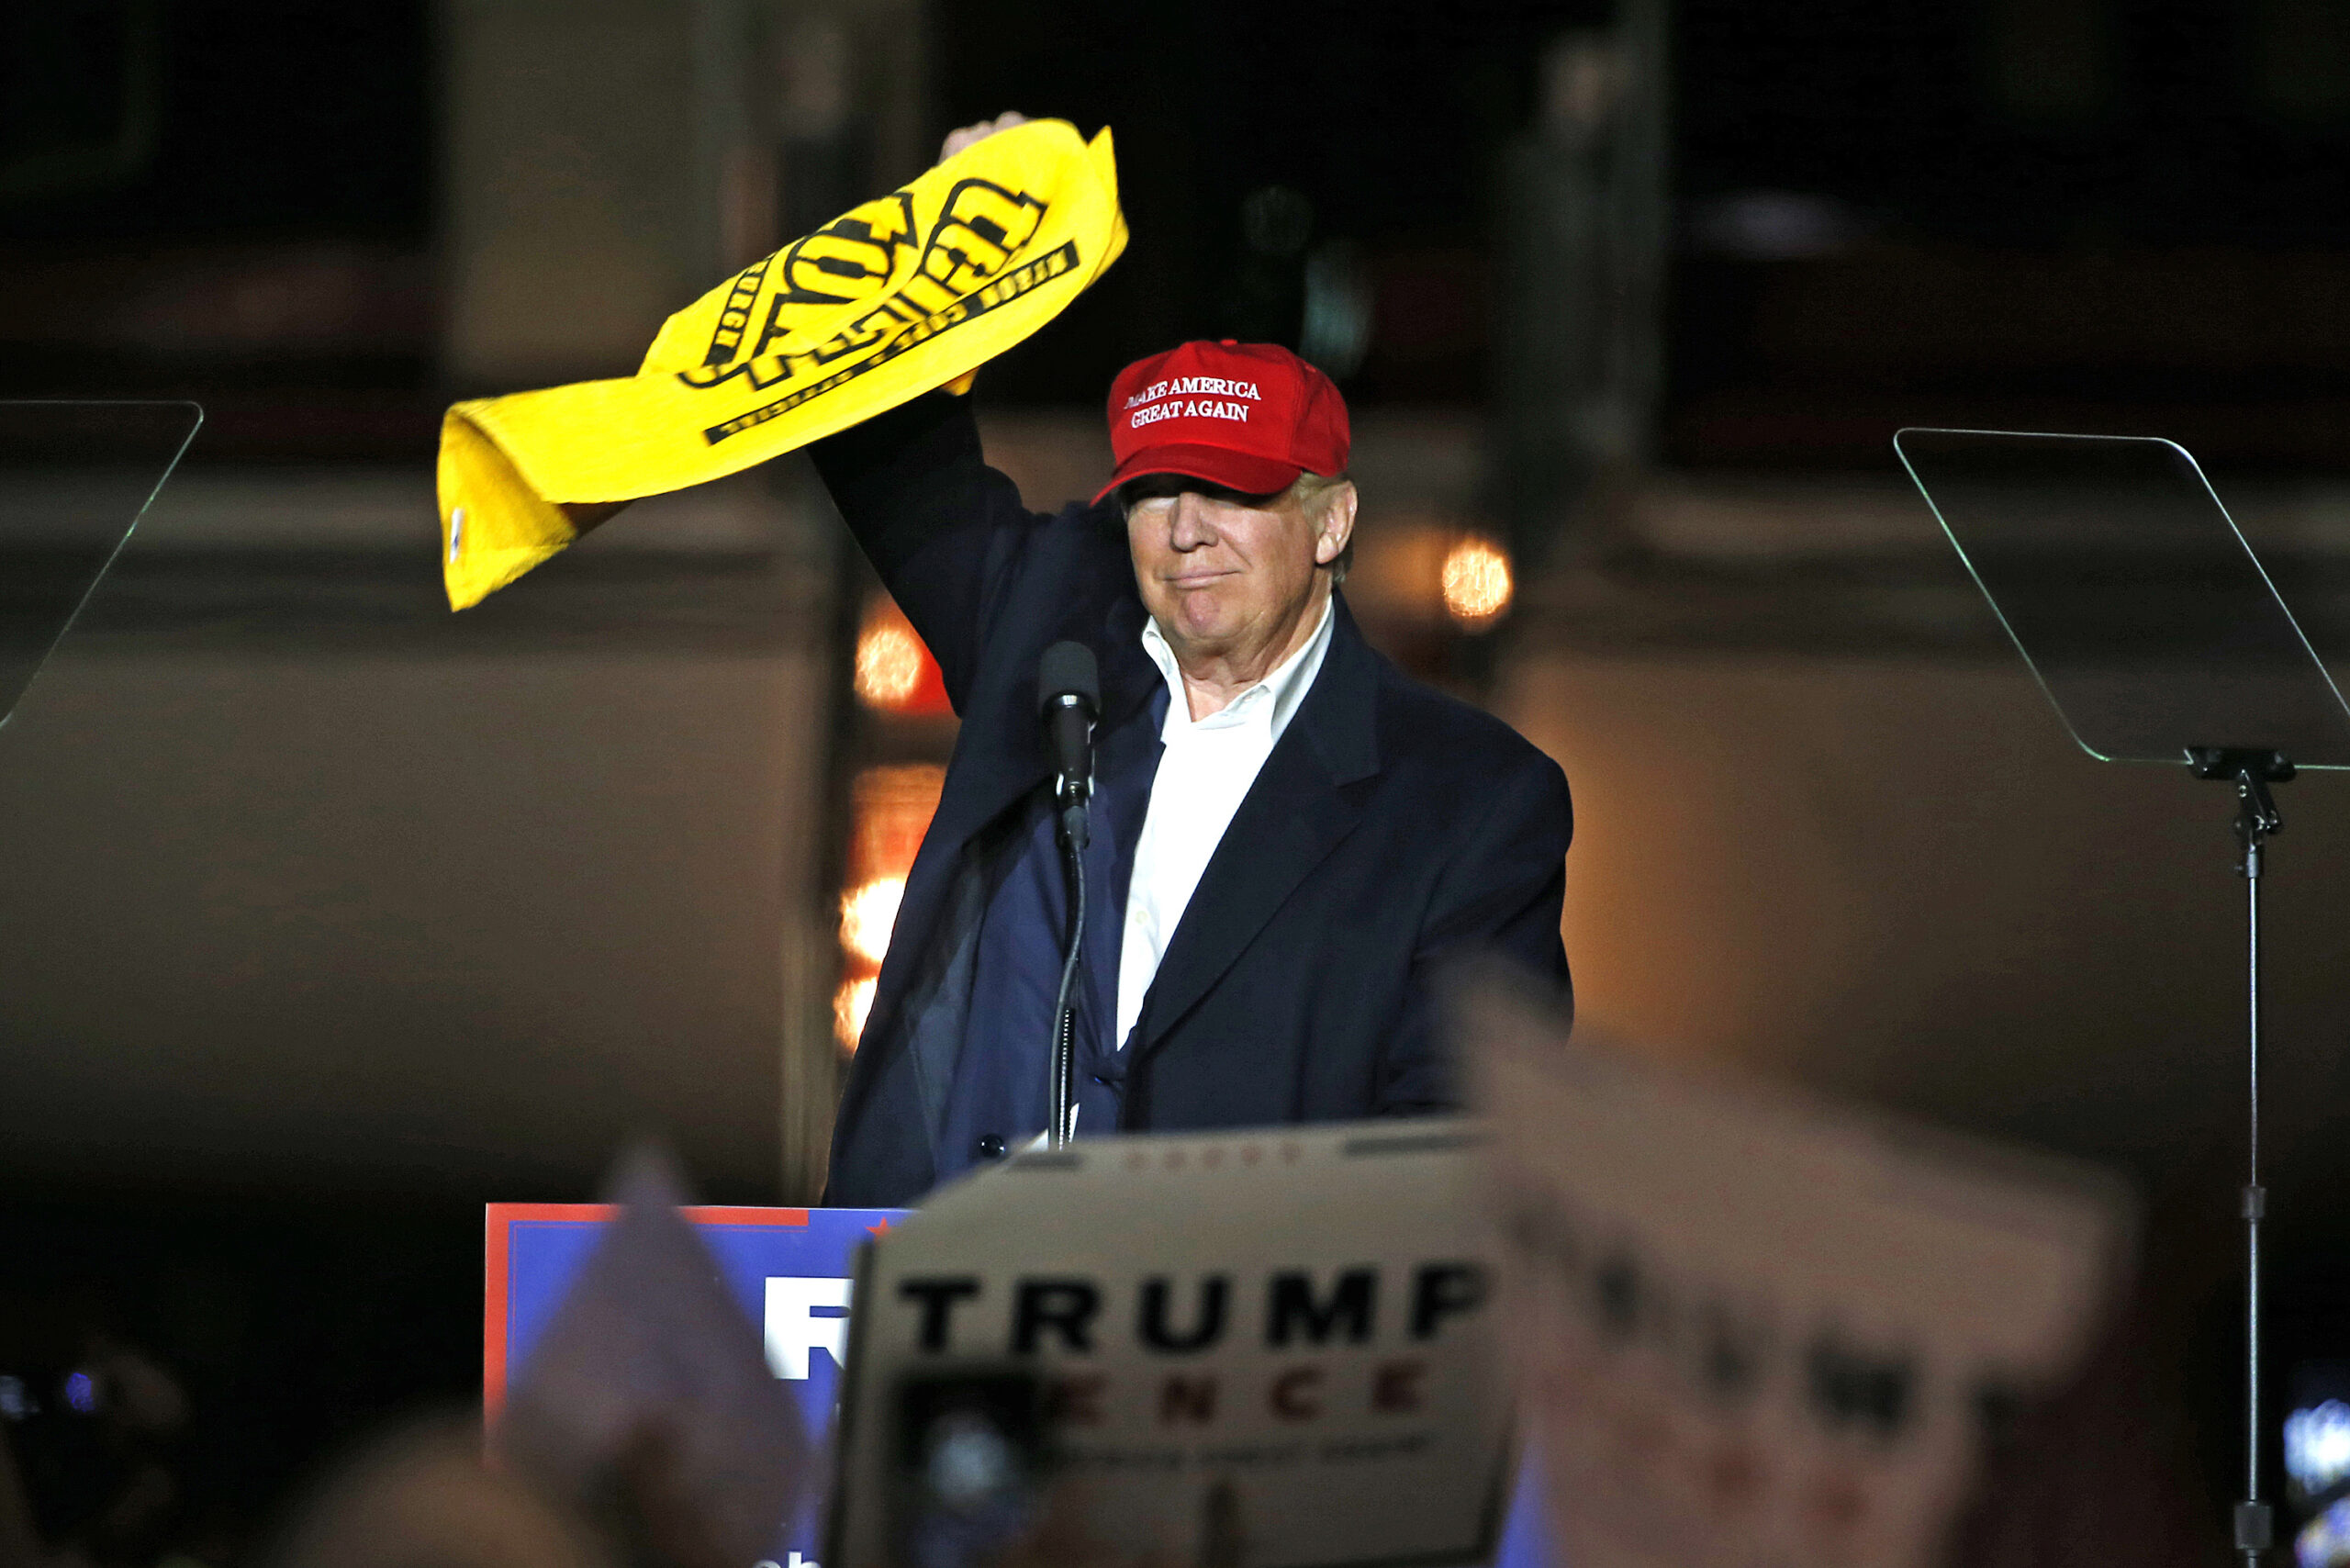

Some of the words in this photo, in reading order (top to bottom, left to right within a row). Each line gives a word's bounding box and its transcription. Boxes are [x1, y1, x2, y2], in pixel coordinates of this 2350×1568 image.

[1124, 380, 1168, 409] MAKE
[1168, 376, 1261, 401] AMERICA
[1131, 400, 1183, 429] GREAT
[1184, 399, 1249, 423] AGAIN
[900, 1258, 1494, 1355] TRUMP
[1048, 1359, 1425, 1427] ENCE
